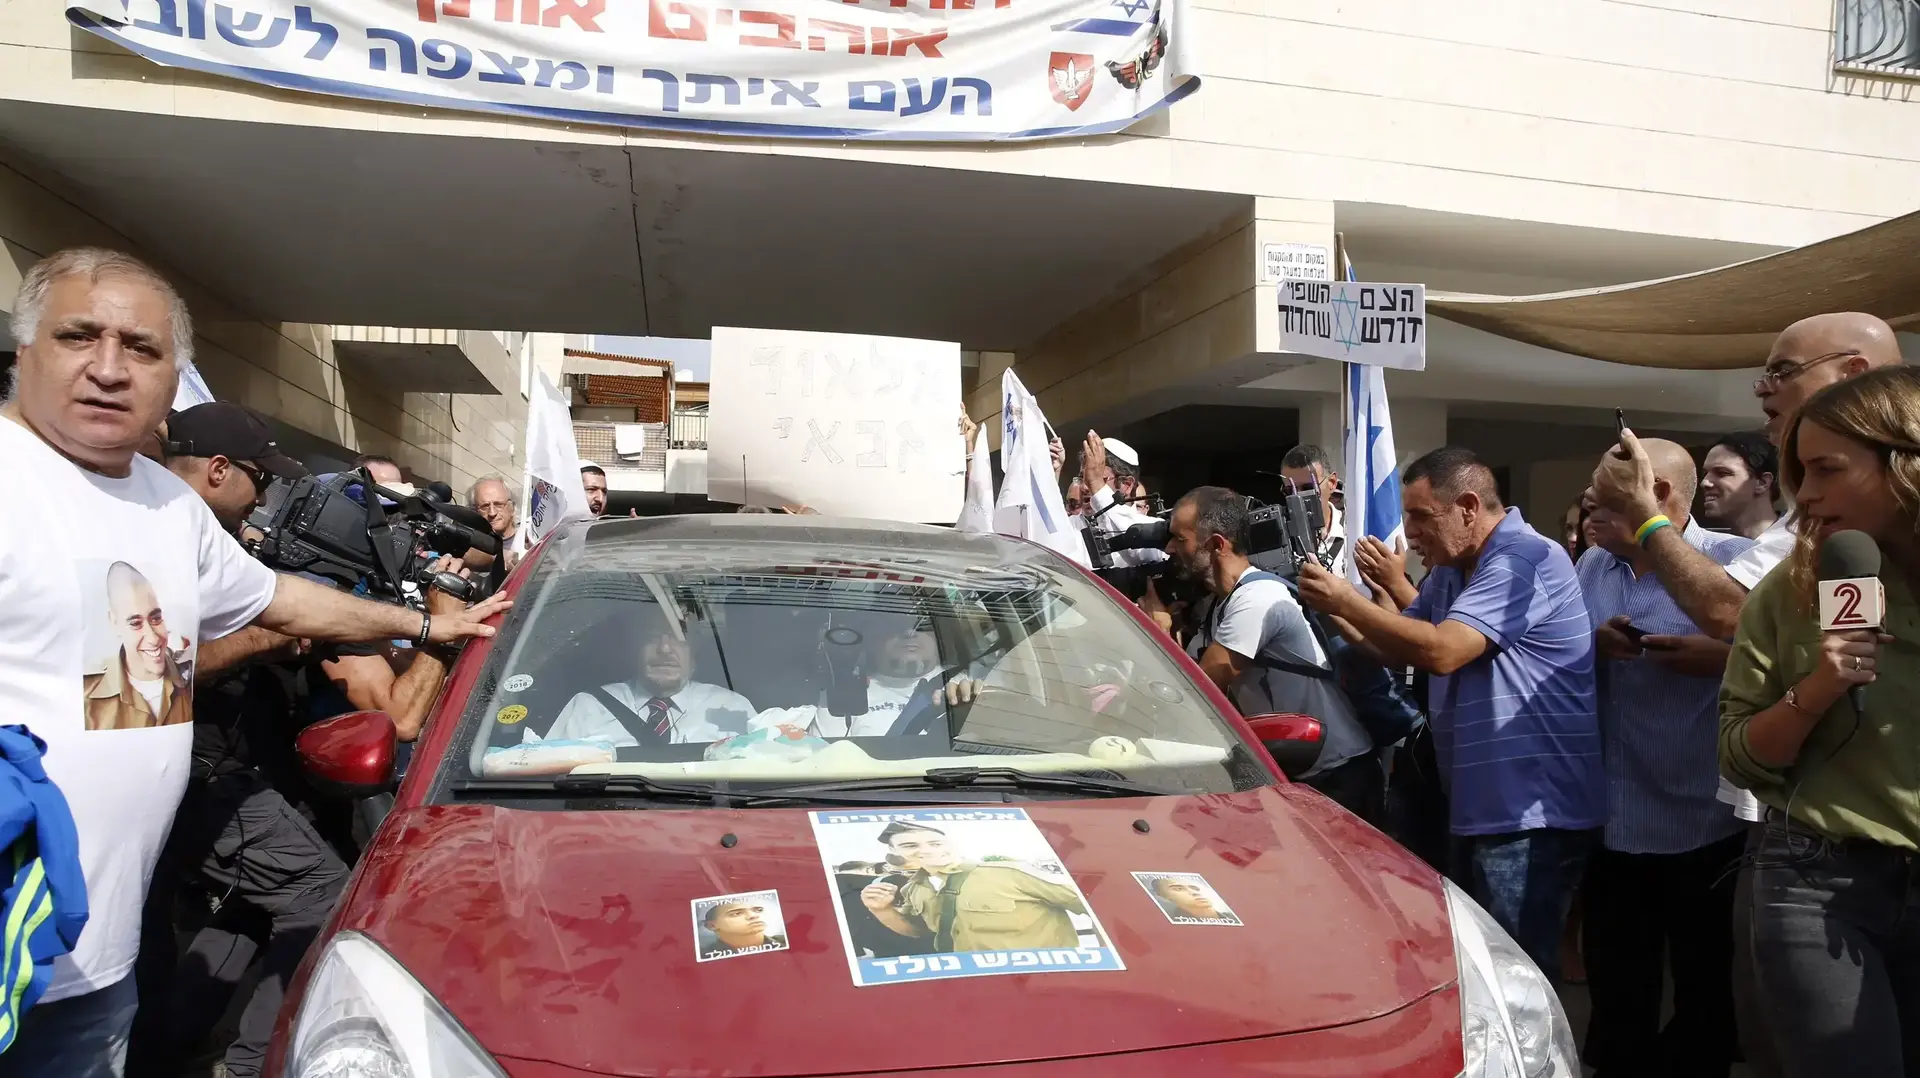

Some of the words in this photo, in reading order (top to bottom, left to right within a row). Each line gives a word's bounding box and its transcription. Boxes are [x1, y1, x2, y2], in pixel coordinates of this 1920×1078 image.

[122, 0, 339, 61] לשוב
[648, 0, 949, 58] אוהבים
[366, 27, 615, 95] ומצפה
[642, 68, 822, 113] איתך
[848, 77, 993, 118] העם
[1286, 281, 1331, 304] השפוי
[1278, 304, 1331, 339] שחרור
[1360, 316, 1423, 344] דורש
[1831, 582, 1868, 626] 2
[827, 812, 917, 824] אזריה
[925, 811, 1017, 822] אלאור
[737, 940, 781, 955] לחופש
[971, 946, 1103, 969] לחופש
[871, 954, 961, 976] נולד
